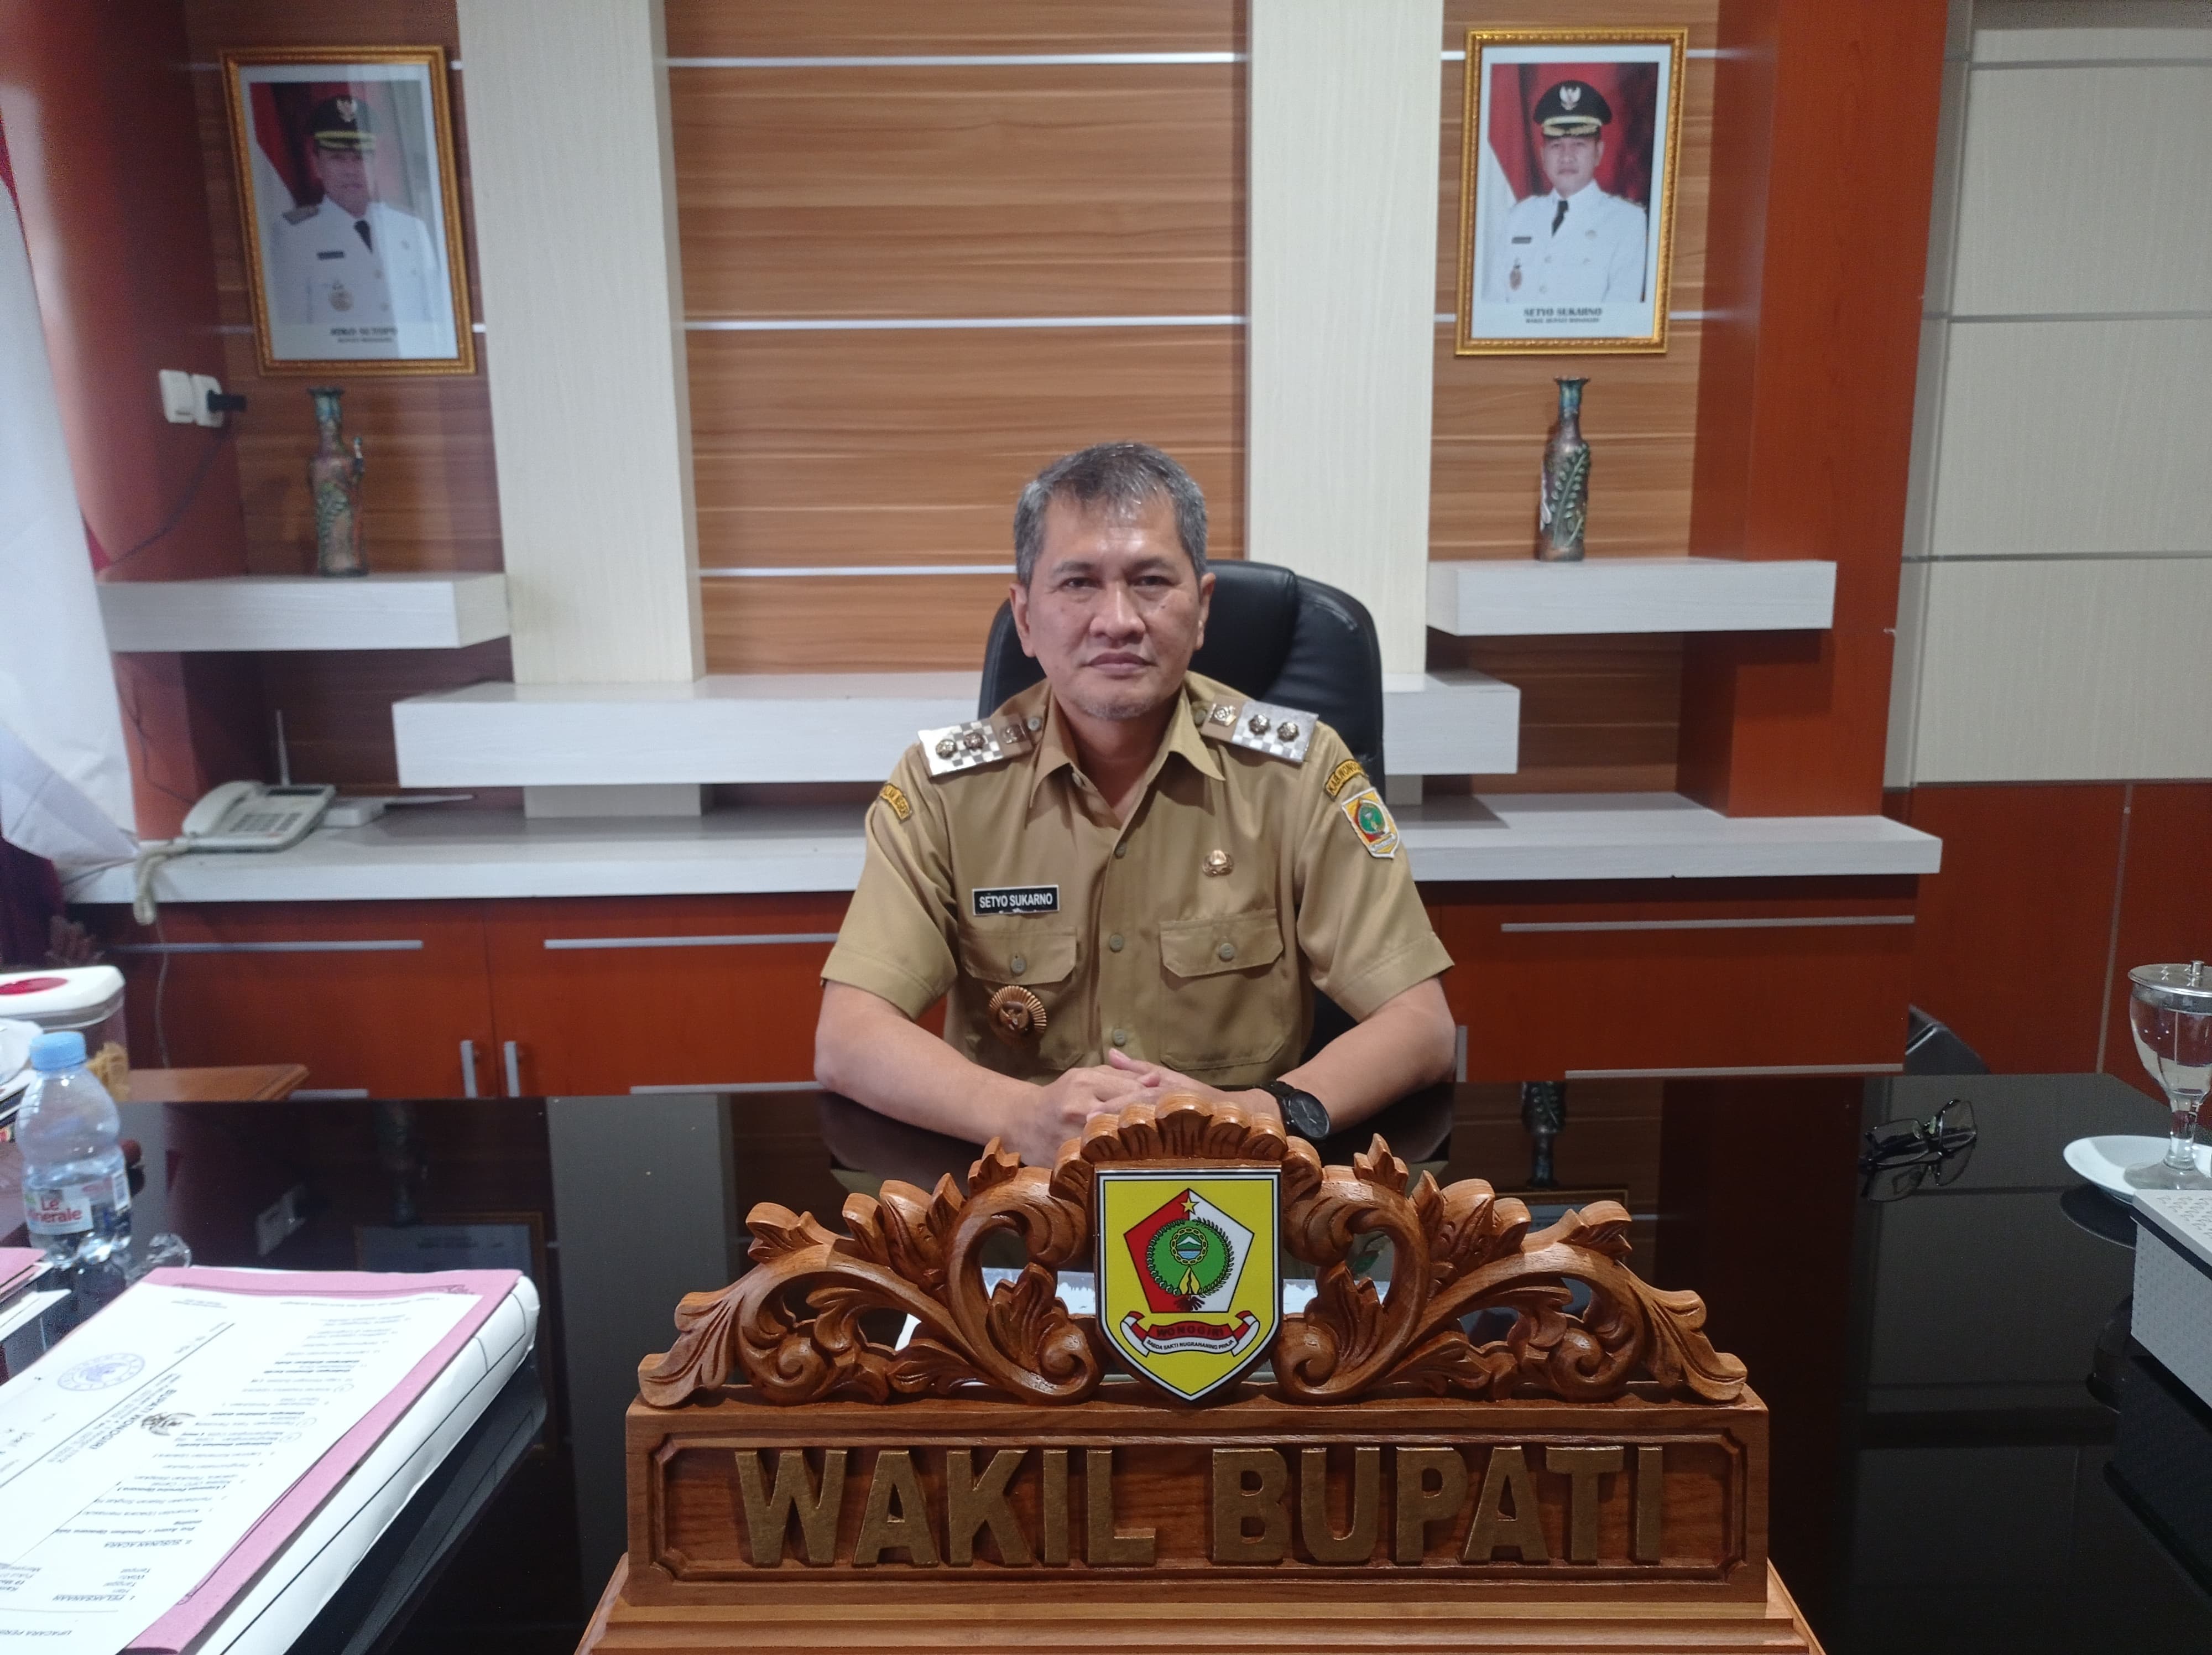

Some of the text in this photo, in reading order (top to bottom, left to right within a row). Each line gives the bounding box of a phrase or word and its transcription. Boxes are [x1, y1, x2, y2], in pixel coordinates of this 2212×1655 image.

[979, 893, 1053, 909] SETYO SUKARNO
[41, 1195, 59, 1211] Le
[1156, 1325, 1224, 1337] WONOGIRI
[1180, 1341, 1218, 1350] NUGRAHANING
[734, 1445, 1663, 1568] WAKIL BUPATI
